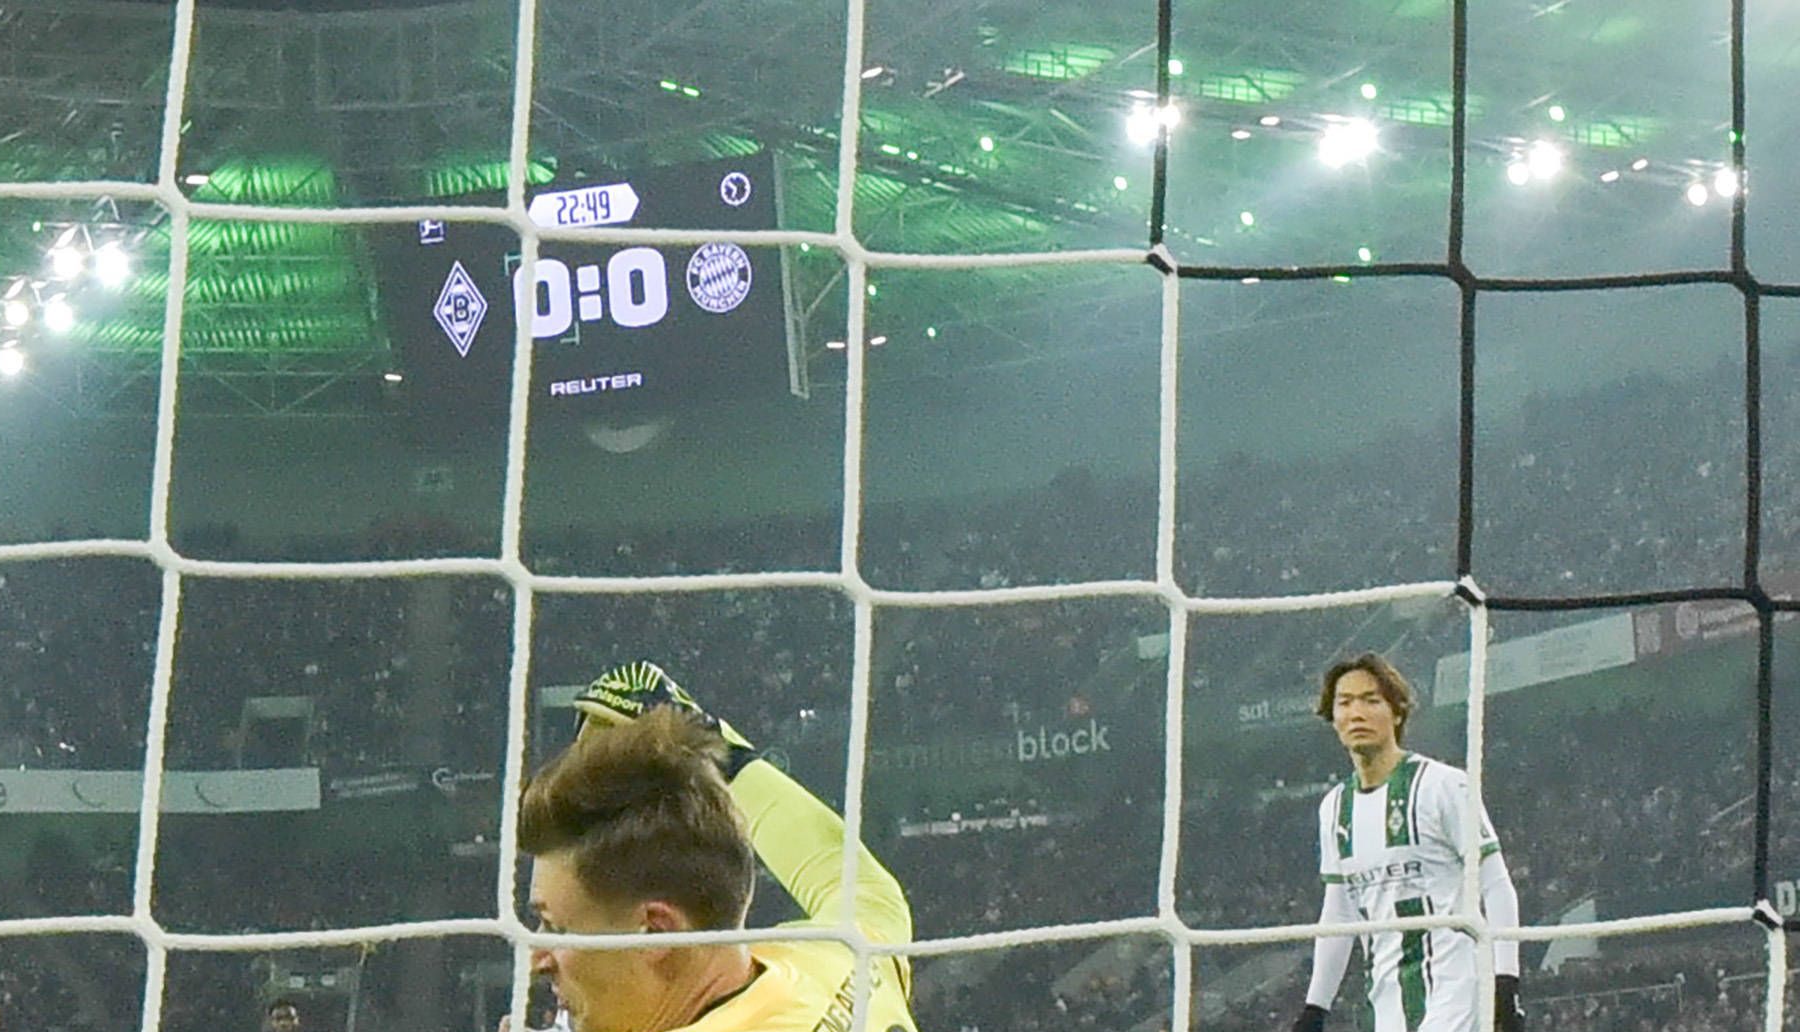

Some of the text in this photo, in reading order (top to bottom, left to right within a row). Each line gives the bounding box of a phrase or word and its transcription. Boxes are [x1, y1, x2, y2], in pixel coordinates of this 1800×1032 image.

[556, 190, 611, 225] 22:49
[513, 247, 669, 338] 0:0
[550, 372, 643, 397] REUTER
[1017, 718, 1111, 762] block
